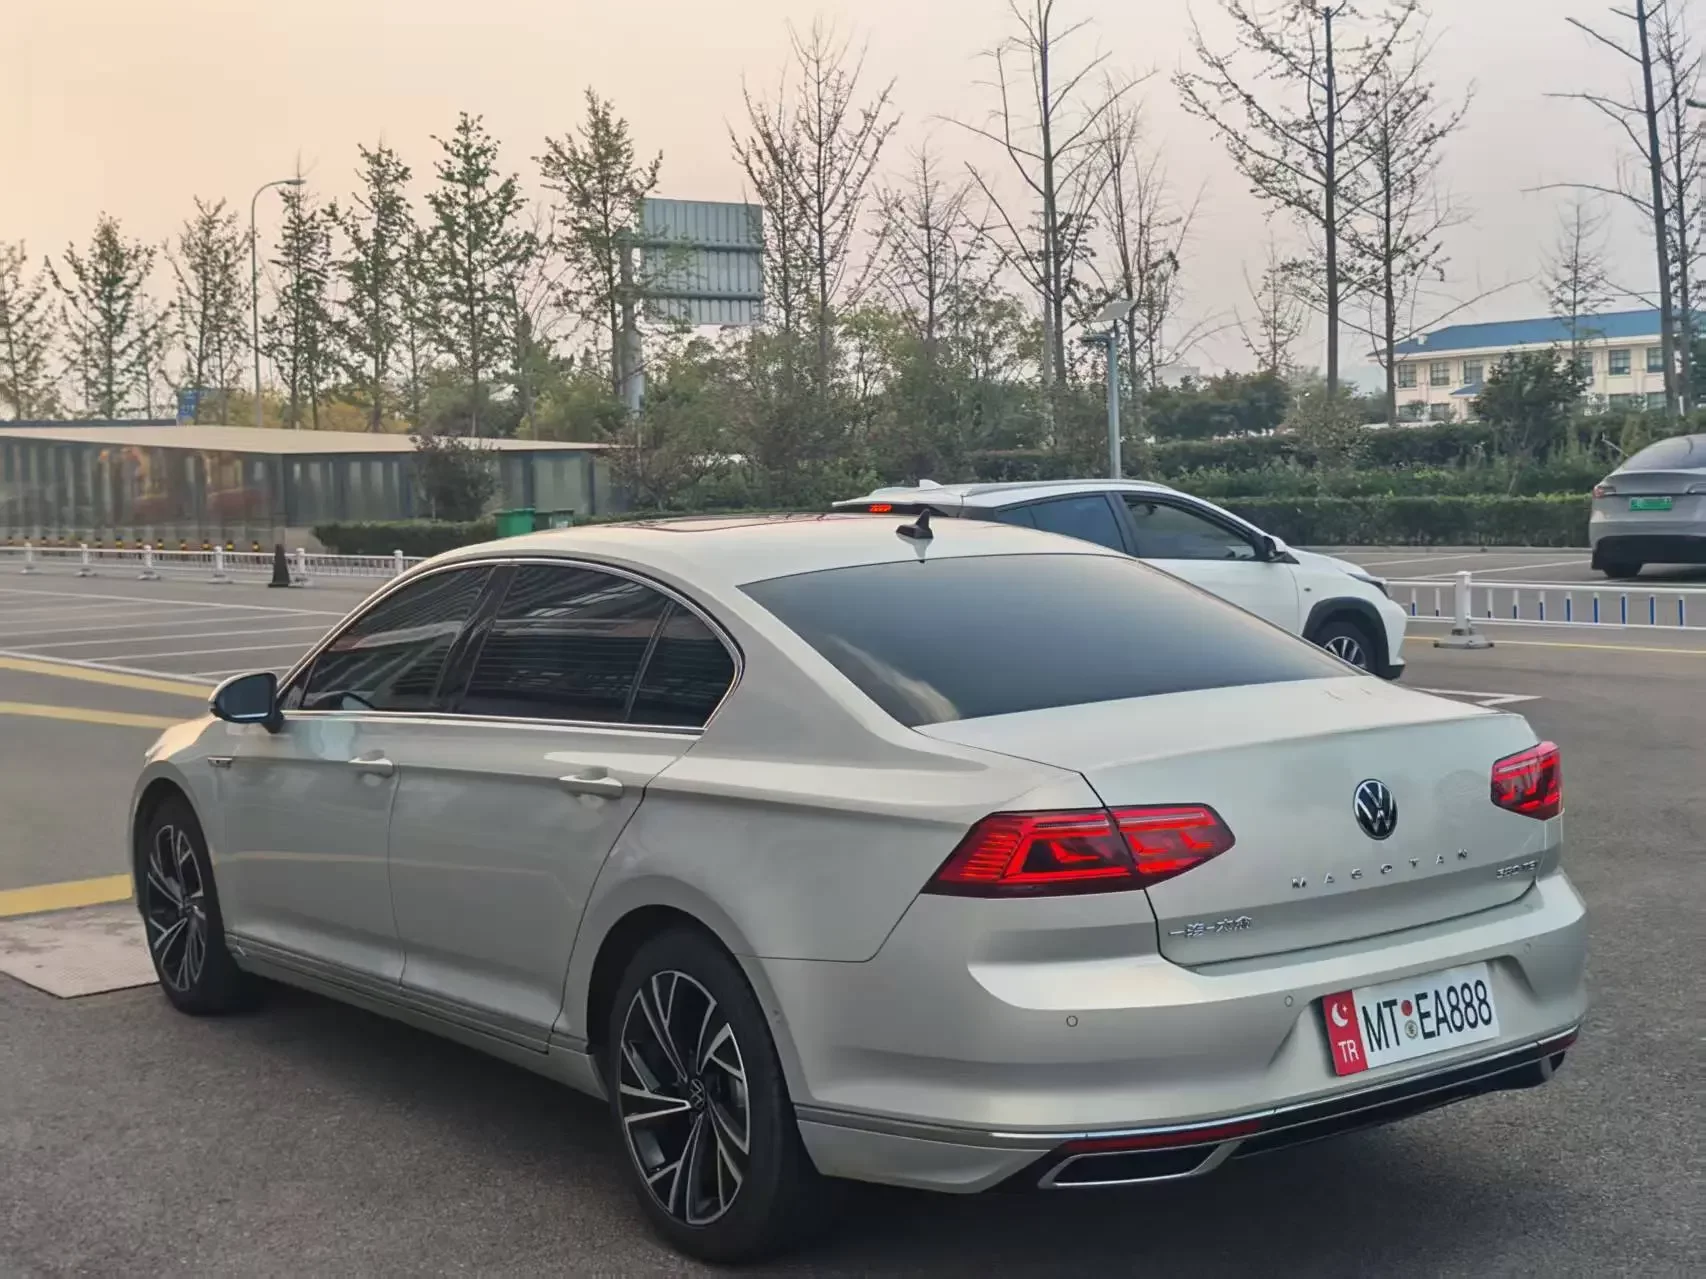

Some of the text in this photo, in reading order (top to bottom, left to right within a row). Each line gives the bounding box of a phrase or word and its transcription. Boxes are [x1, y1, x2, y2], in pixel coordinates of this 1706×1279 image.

[1291, 848, 1468, 888] MAGOTAN
[1361, 979, 1493, 1052] MT EA888
[1337, 1039, 1360, 1064] TR
